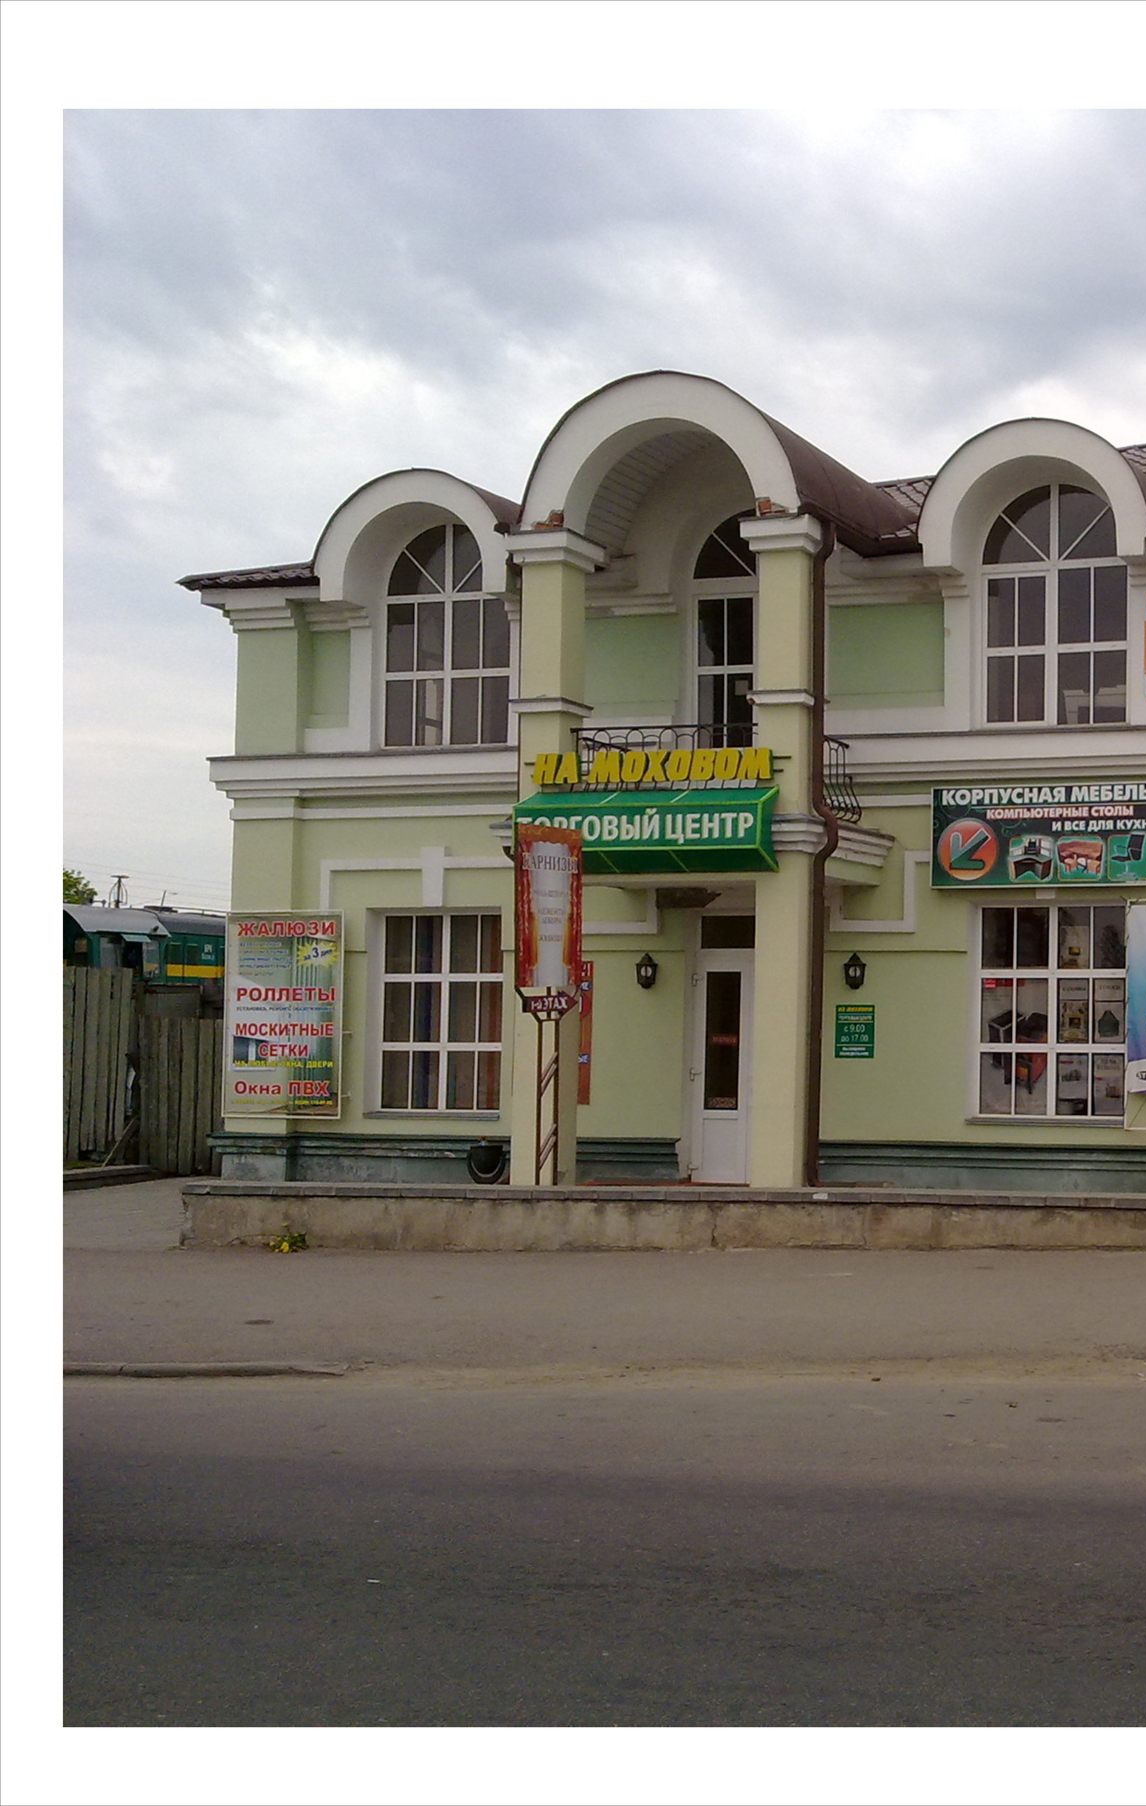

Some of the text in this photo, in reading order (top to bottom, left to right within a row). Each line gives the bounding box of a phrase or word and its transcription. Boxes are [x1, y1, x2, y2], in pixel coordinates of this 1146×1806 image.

[533, 748, 774, 784] НА МОХОВОМ
[942, 786, 1067, 806] КОРПУСНАЯ
[986, 805, 1134, 820] КОМПЬЮТЕРНЫЕ СТОЛЫ
[665, 812, 755, 844] ЦЕНТР
[1052, 821, 1062, 832] И
[1064, 820, 1086, 832] ВСЕ
[1088, 820, 1114, 832] ДЛЯ
[522, 853, 578, 873] КАРНИЗЫ
[237, 921, 336, 936] ЖАЛЮЗИ
[312, 946, 319, 958] 3
[236, 987, 336, 1002] РОЛЛЕТЫ
[235, 1023, 334, 1036] МОСКИТНЫЕ
[259, 1044, 309, 1057] СЕТКИ
[234, 1081, 330, 1096] Окна ПВХ
